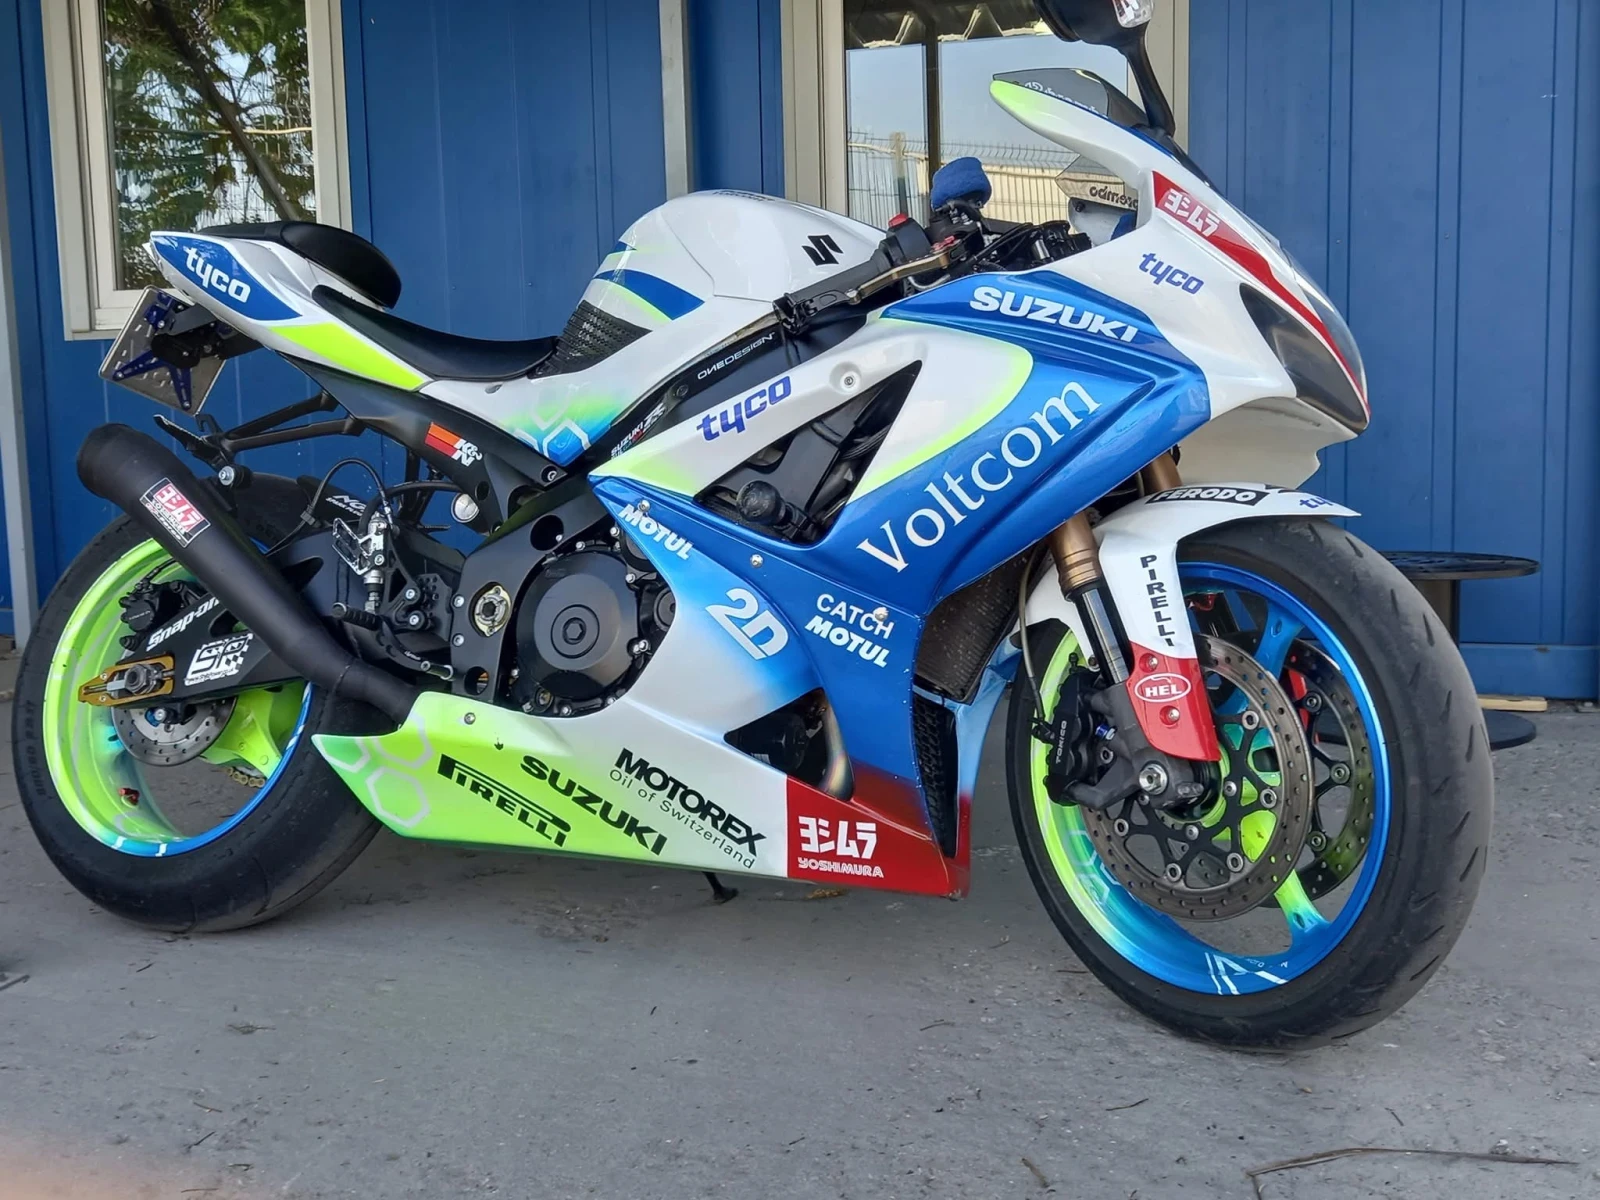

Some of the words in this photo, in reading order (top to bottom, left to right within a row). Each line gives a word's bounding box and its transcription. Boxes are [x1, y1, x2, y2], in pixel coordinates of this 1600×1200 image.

[184, 247, 251, 303] tyco
[1139, 253, 1204, 295] tyco
[969, 286, 1139, 343] SUZUKI
[697, 333, 773, 379] ONEDESIGN
[696, 375, 792, 441] tyco
[451, 438, 482, 467] K&N
[856, 380, 1102, 573] Voltcom
[1154, 488, 1256, 502] FERODO
[619, 504, 694, 560] MOTUL
[146, 597, 220, 652] Snap-on
[705, 588, 789, 660] 2D
[816, 594, 894, 639] CATCH
[1140, 554, 1177, 647] PIRELLI
[805, 616, 890, 667] MOTUL
[1145, 684, 1182, 698] HEL
[1056, 720, 1067, 764] TOKICO
[437, 754, 571, 847] PIRELLI
[520, 755, 667, 855] SUZUKI
[609, 769, 633, 789] Oil
[638, 788, 656, 802] of
[660, 800, 755, 869] Switzerland
[615, 748, 767, 857] MOTOREX
[798, 816, 877, 859] ヨシムラ
[797, 857, 884, 878] YOSHIMURA
